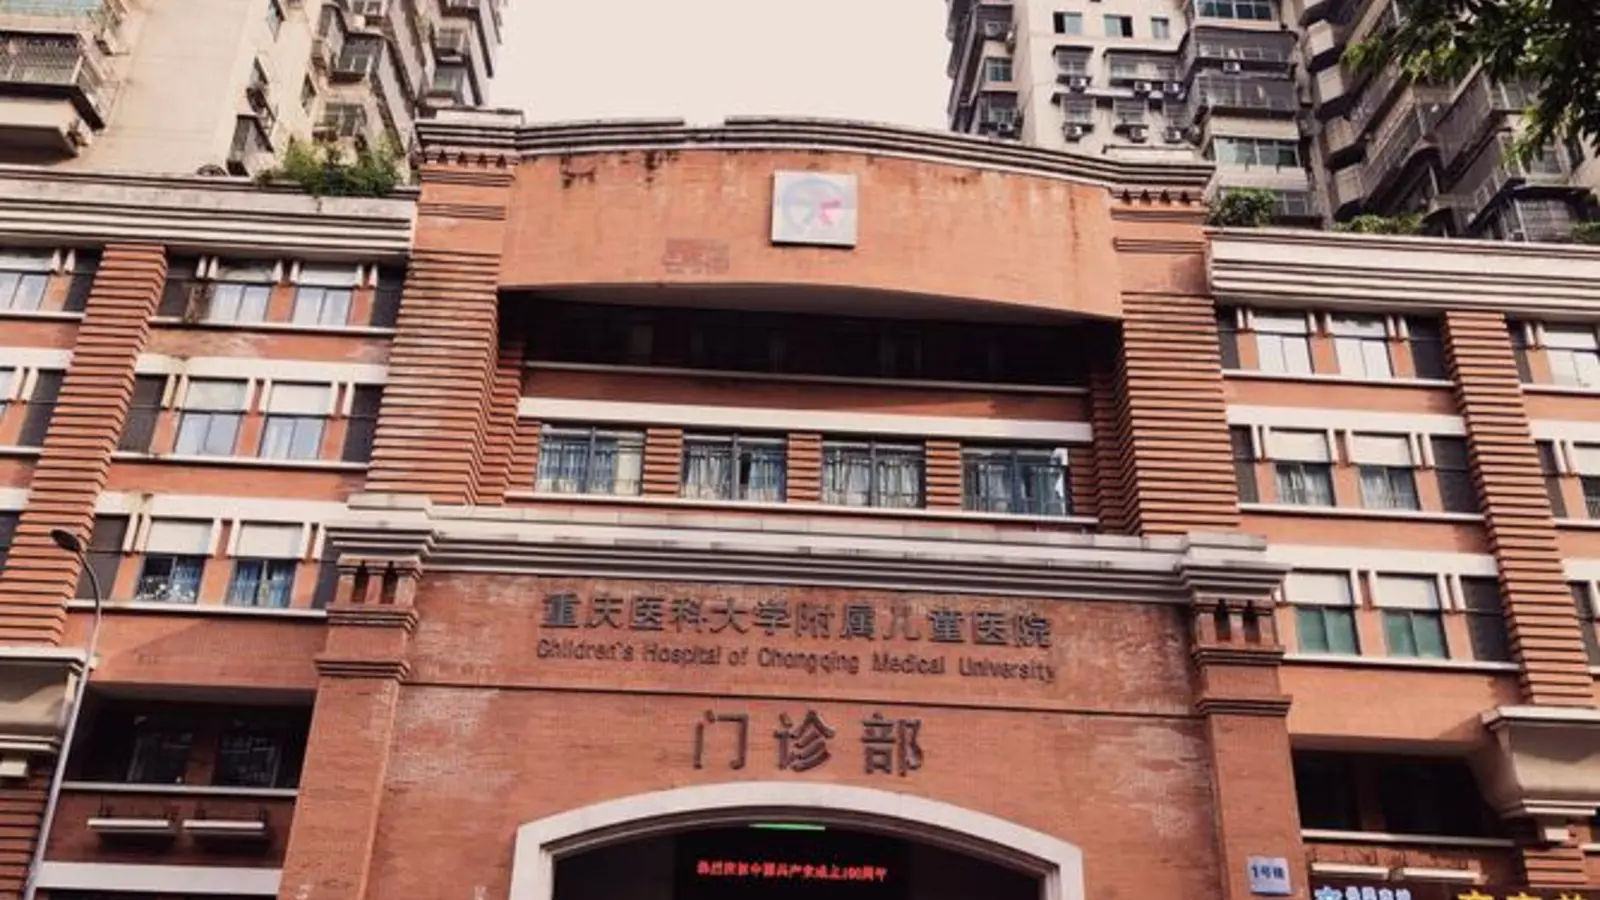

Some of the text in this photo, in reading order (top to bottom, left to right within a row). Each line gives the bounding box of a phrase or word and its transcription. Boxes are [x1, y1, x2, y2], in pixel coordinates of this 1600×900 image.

[539, 591, 1052, 648] 重庆医科大学附属儿童医院
[536, 638, 1056, 683] Children's Hospital of Chongqing Medical University
[693, 709, 925, 778] 门诊部
